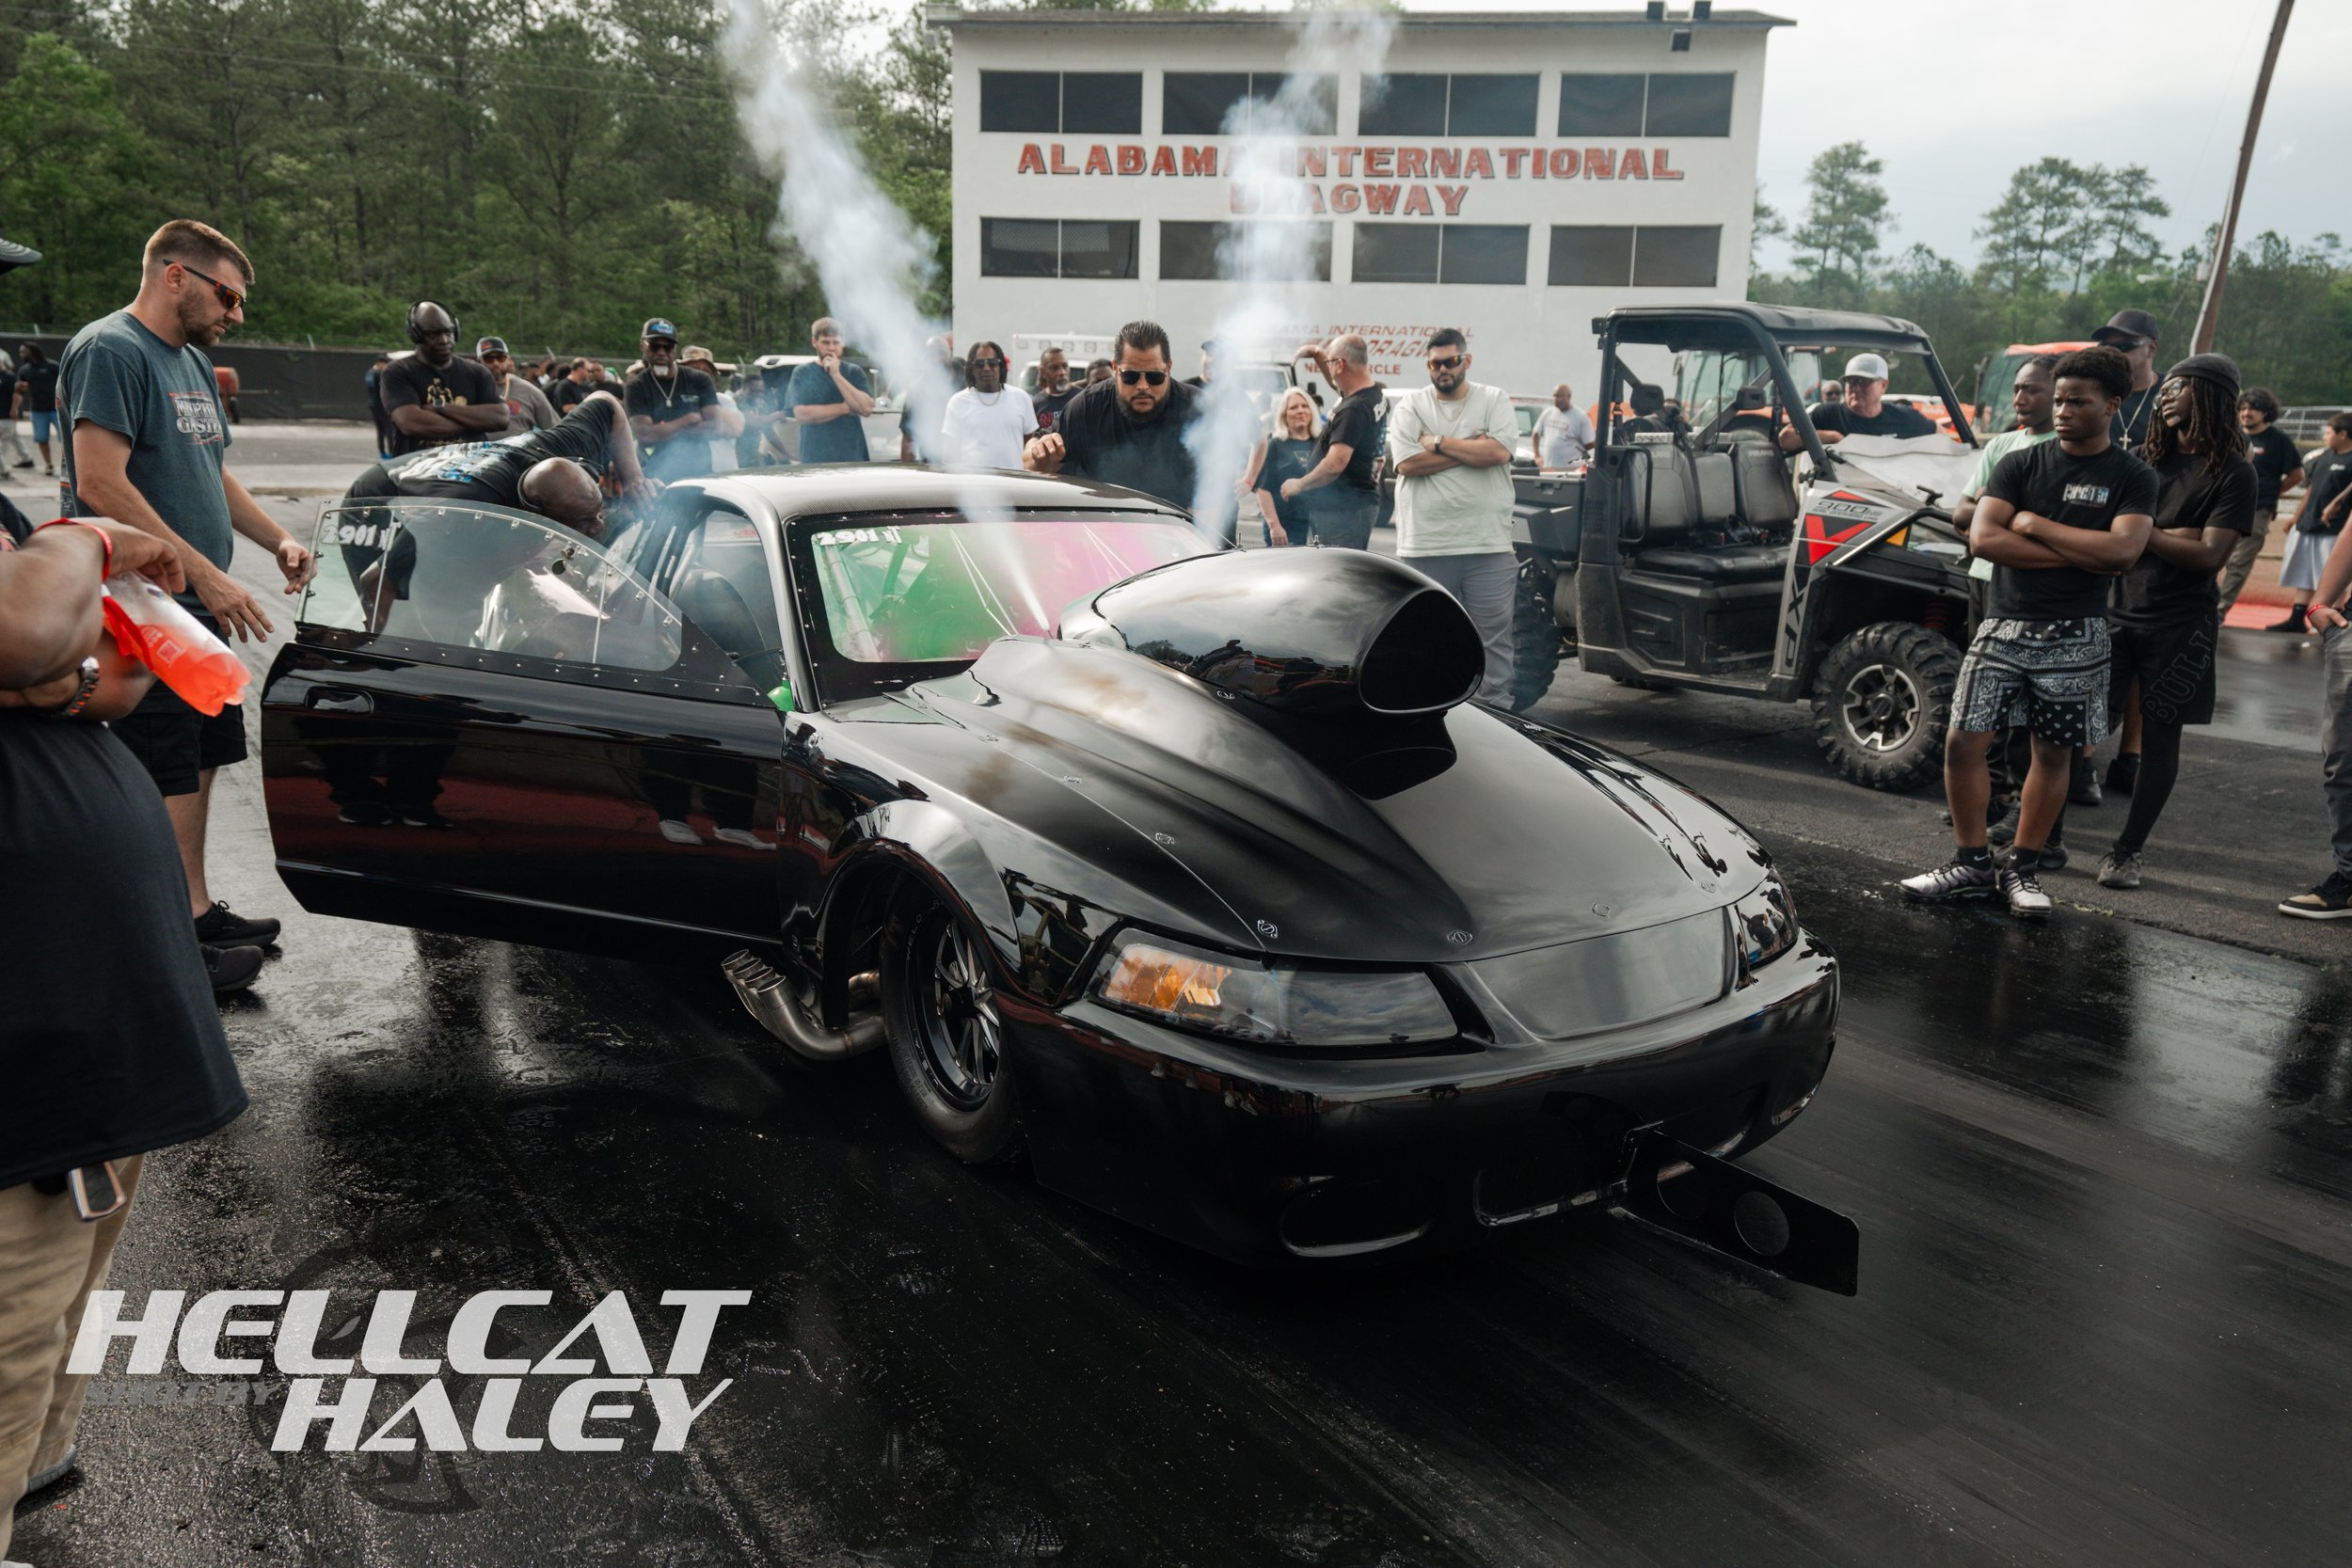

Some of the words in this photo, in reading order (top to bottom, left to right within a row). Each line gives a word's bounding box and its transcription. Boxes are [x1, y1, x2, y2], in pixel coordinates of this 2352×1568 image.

[1018, 143, 1251, 177] ALABAMA
[1279, 146, 1684, 181] INTERNATIONAL
[1229, 182, 1469, 215] DAGWAY
[322, 524, 377, 546] 2901
[817, 529, 880, 546] 2901
